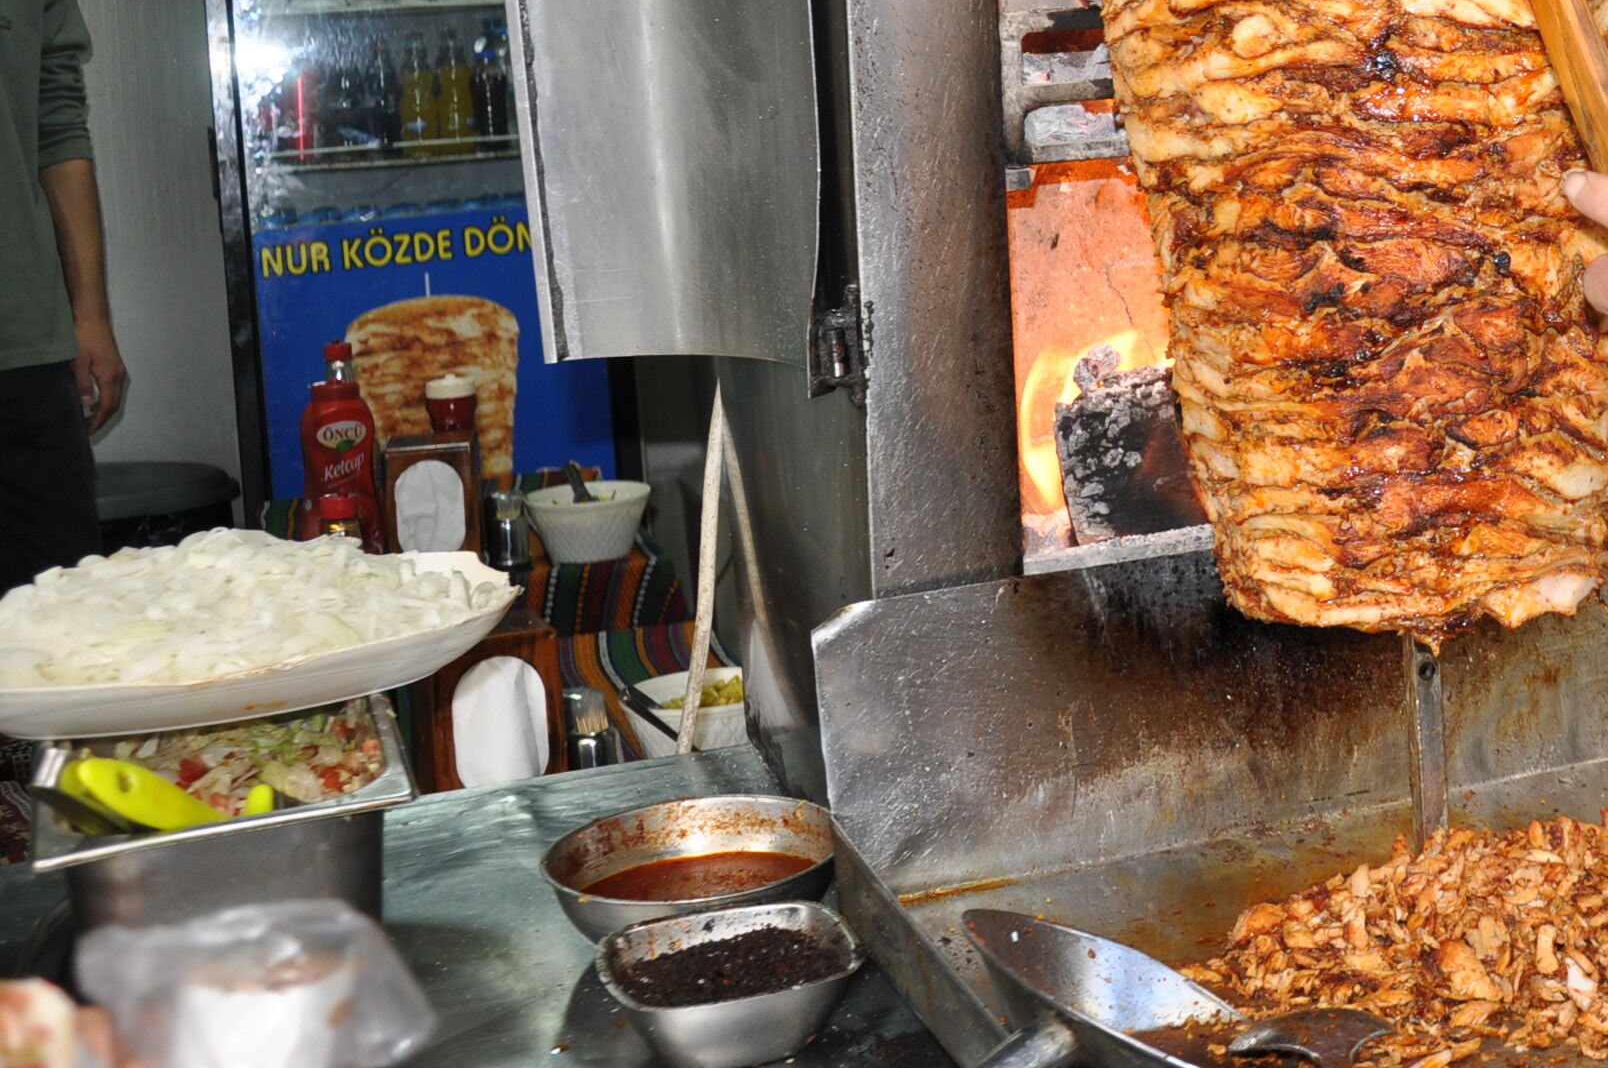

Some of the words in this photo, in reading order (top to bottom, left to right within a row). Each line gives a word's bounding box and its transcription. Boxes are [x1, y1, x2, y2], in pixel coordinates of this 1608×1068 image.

[260, 241, 331, 279] NUR
[342, 228, 453, 271] KÖZDE
[322, 422, 362, 442] ÖNCÜ
